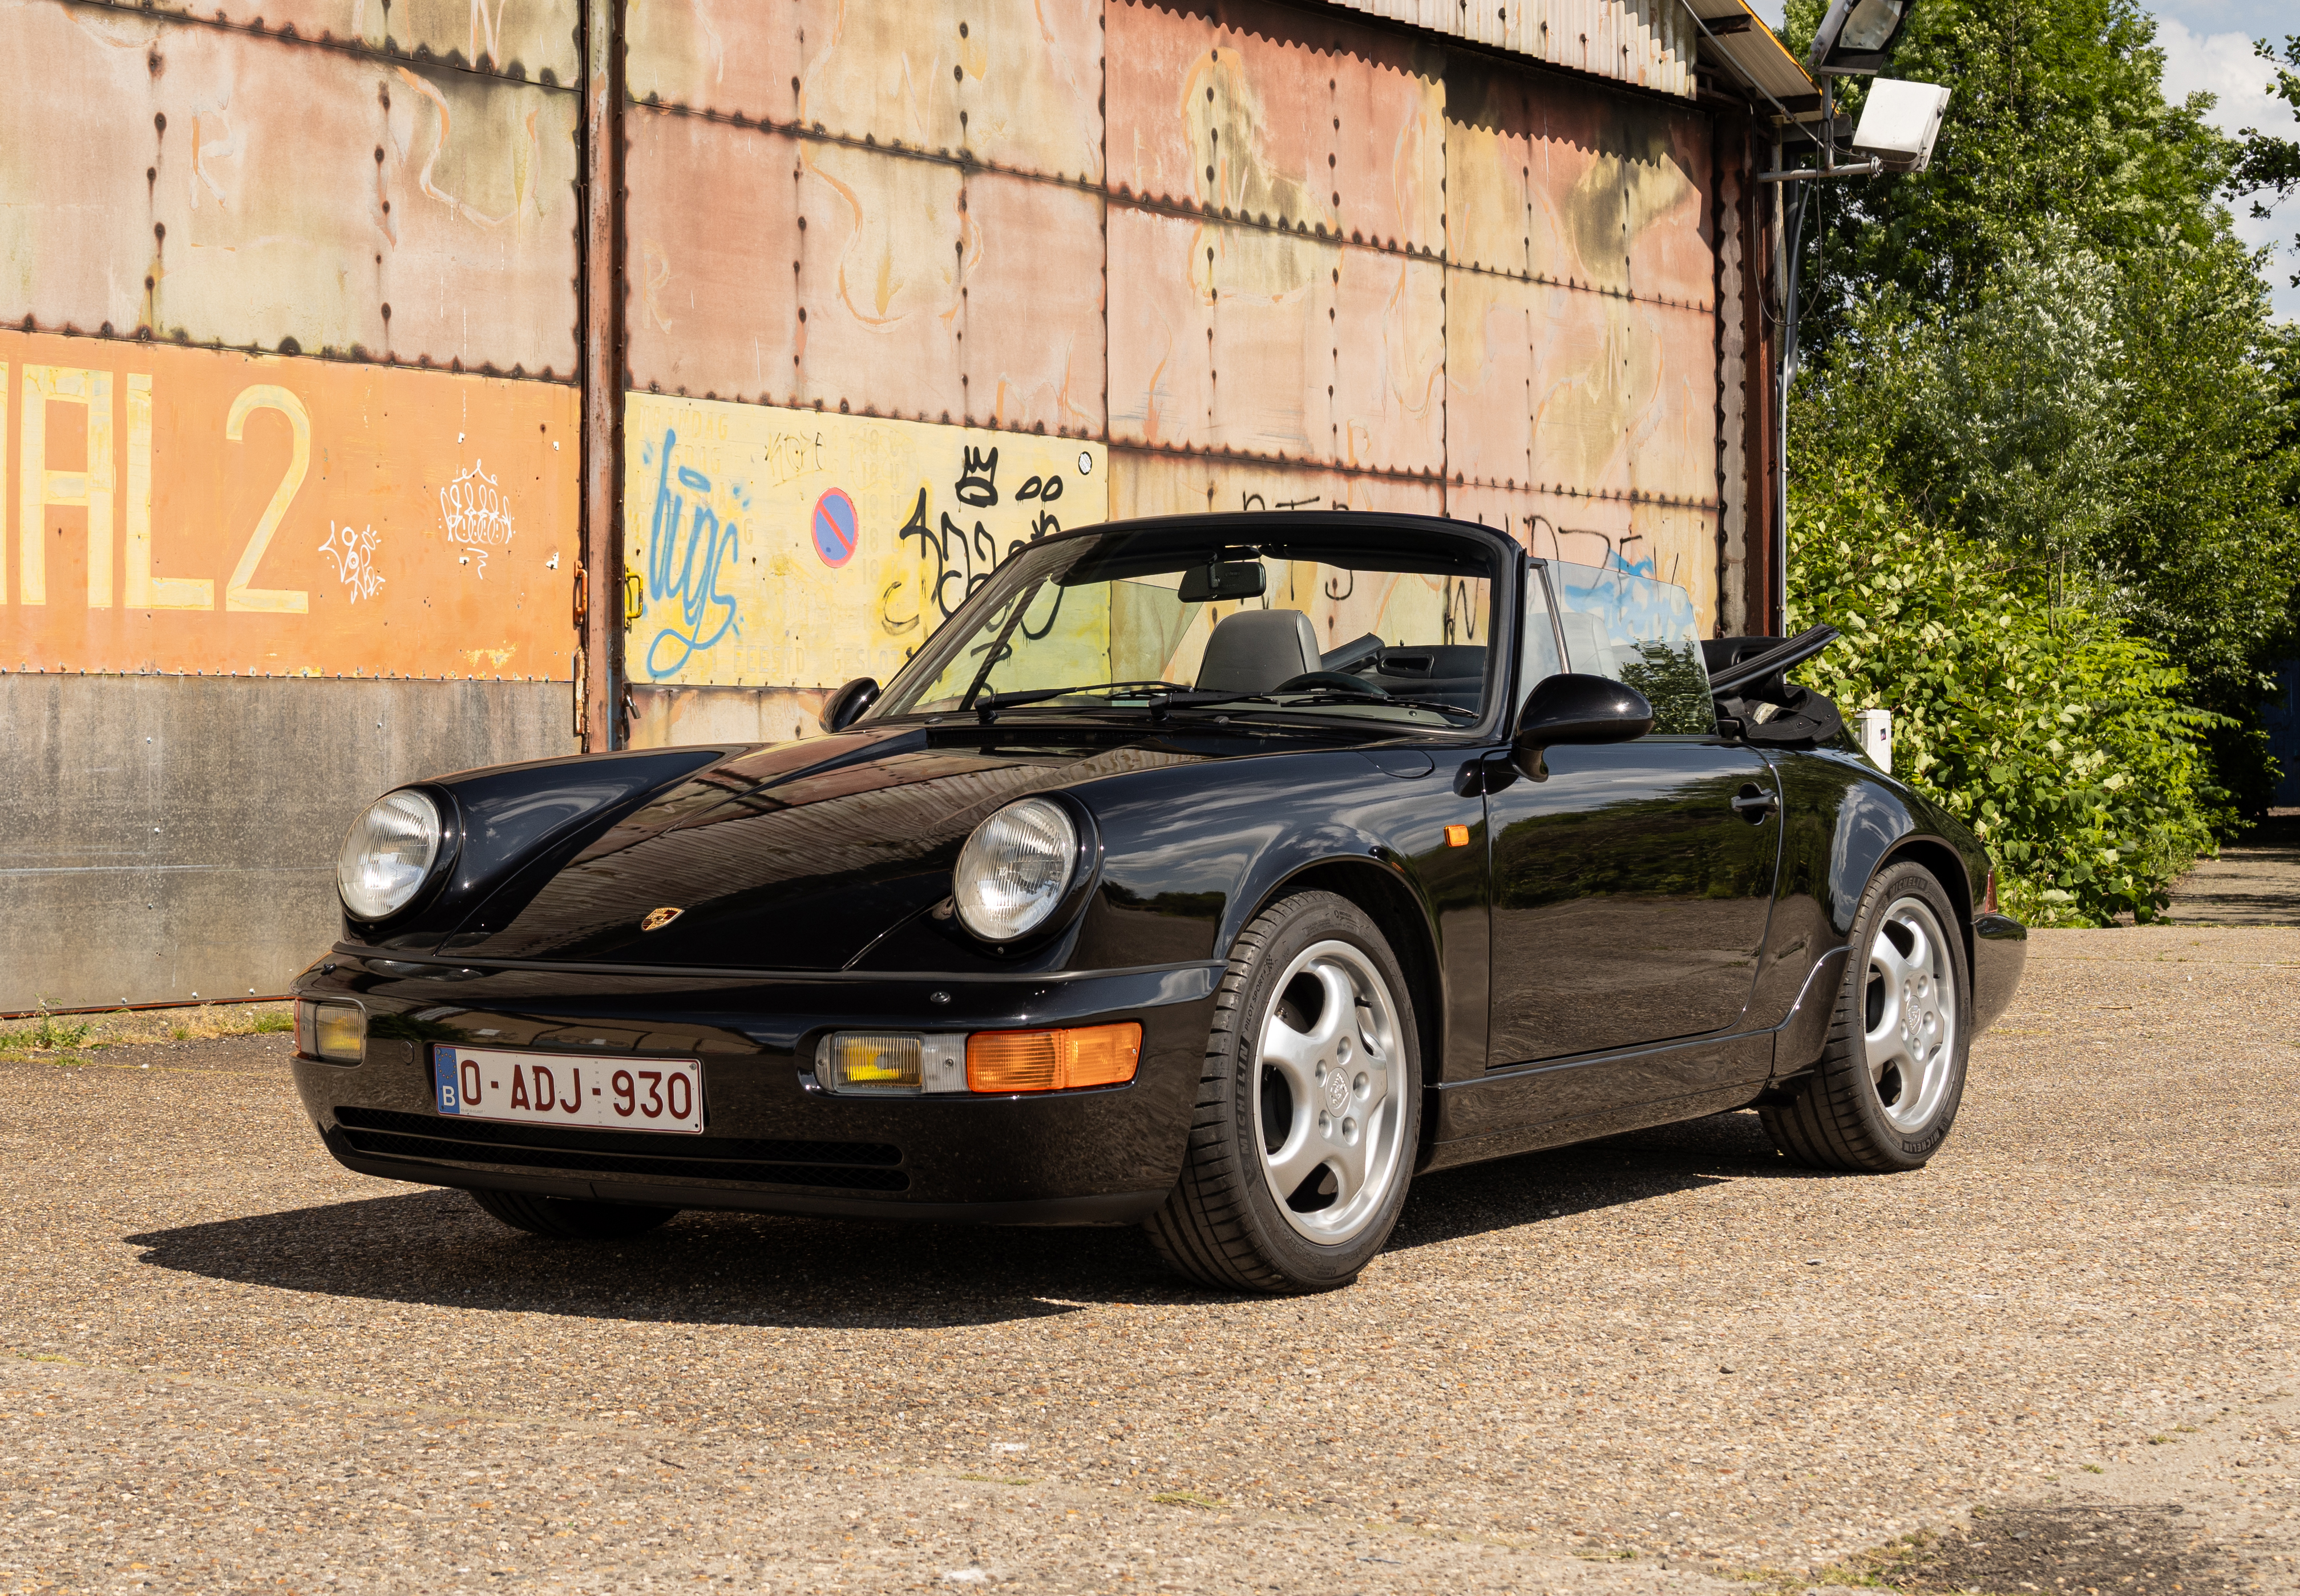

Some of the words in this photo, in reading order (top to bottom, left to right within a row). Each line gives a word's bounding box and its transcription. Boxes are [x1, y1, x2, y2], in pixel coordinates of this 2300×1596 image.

[0, 362, 215, 611] AL
[226, 384, 311, 614] 2
[832, 647, 900, 675] GESLOT
[1890, 877, 1926, 898] MICHELIN
[1237, 1044, 1250, 1155] MICHELIN
[1244, 1003, 1254, 1031] PILOT
[1252, 973, 1264, 1003] SPORT
[442, 1085, 456, 1107] B
[1903, 1129, 1940, 1152] MICHELIN
